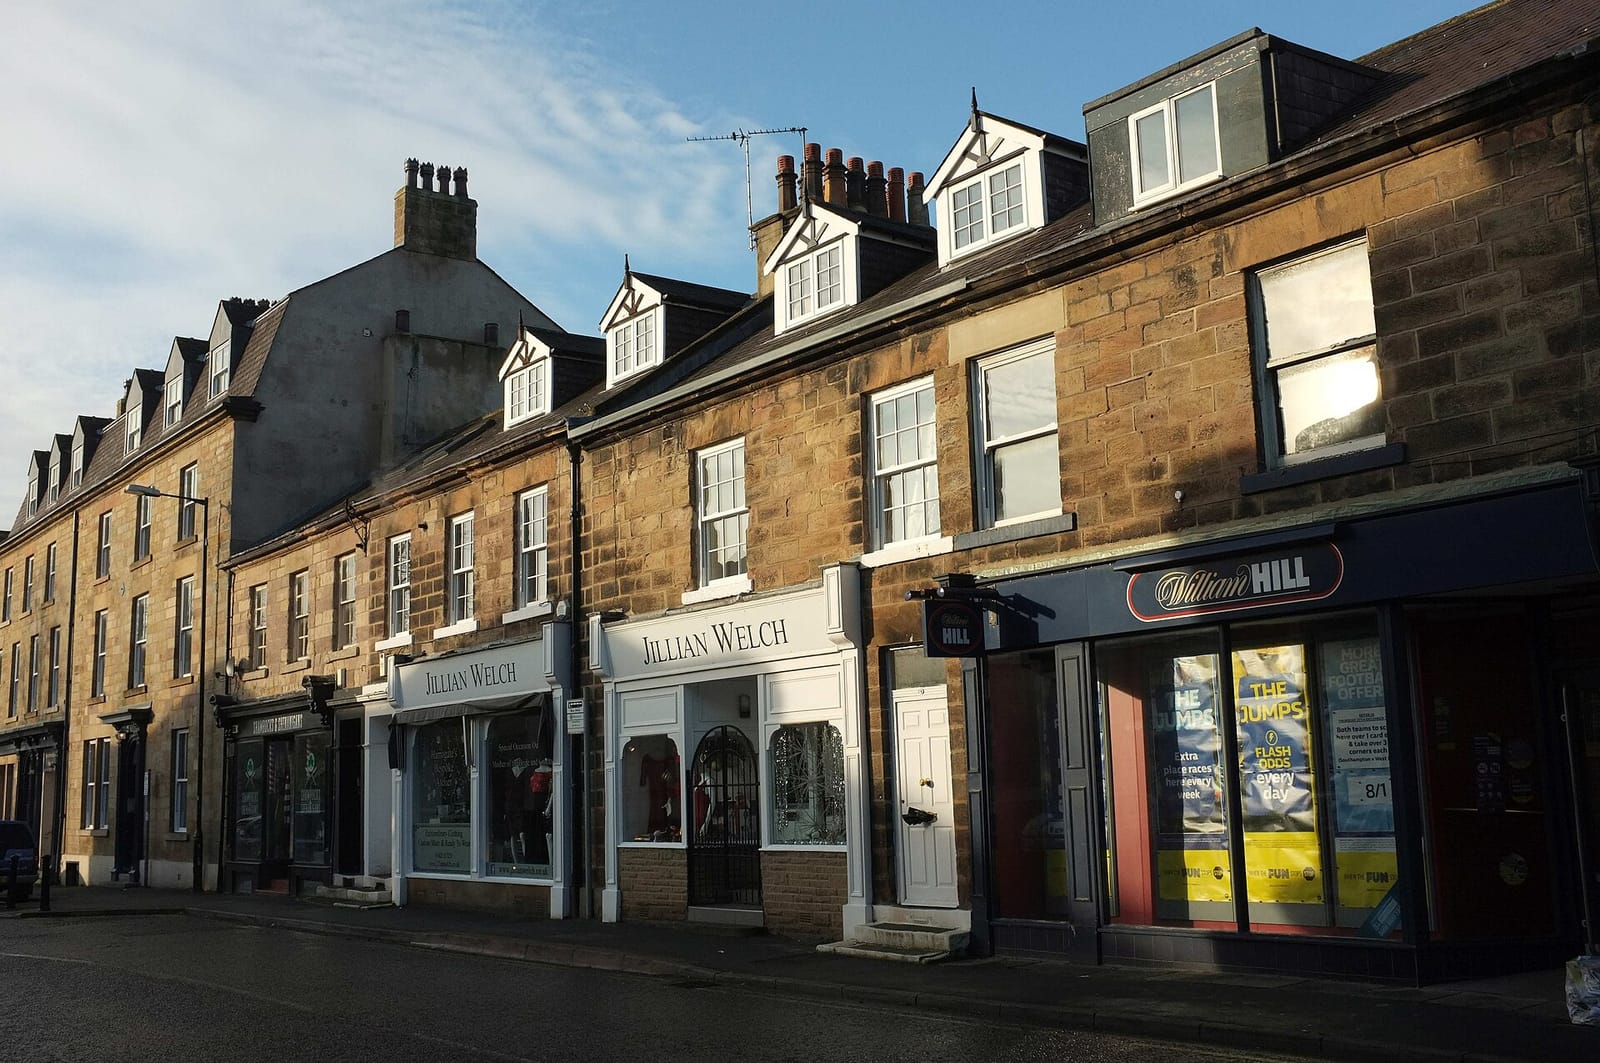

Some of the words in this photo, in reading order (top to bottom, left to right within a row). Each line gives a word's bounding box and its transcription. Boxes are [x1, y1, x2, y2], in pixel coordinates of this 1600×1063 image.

[1155, 564, 1251, 607] William
[1251, 556, 1311, 594] HILL
[642, 631, 709, 665] JILLIAN
[711, 618, 789, 653] WELCH
[942, 627, 970, 645] HILL
[425, 670, 468, 696] JILLIAN
[470, 662, 517, 688] WELCH
[1250, 681, 1288, 700] THE
[1167, 689, 1201, 708] THE
[1156, 708, 1216, 731] JUMPS
[1240, 701, 1304, 723] JUMPS
[1174, 751, 1199, 761] Extra
[1256, 746, 1291, 757] FLASH
[1163, 765, 1187, 776] place
[1188, 764, 1212, 774] races
[1258, 757, 1291, 769] ODDS
[1165, 777, 1184, 787] here
[1187, 776, 1211, 788] every
[1256, 772, 1294, 786] every
[1177, 788, 1201, 799] week
[1263, 785, 1289, 802] day
[1365, 782, 1387, 799] 8/1
[1181, 867, 1201, 878] FUN
[1268, 868, 1290, 879] FUN
[1366, 871, 1389, 883] FUN
